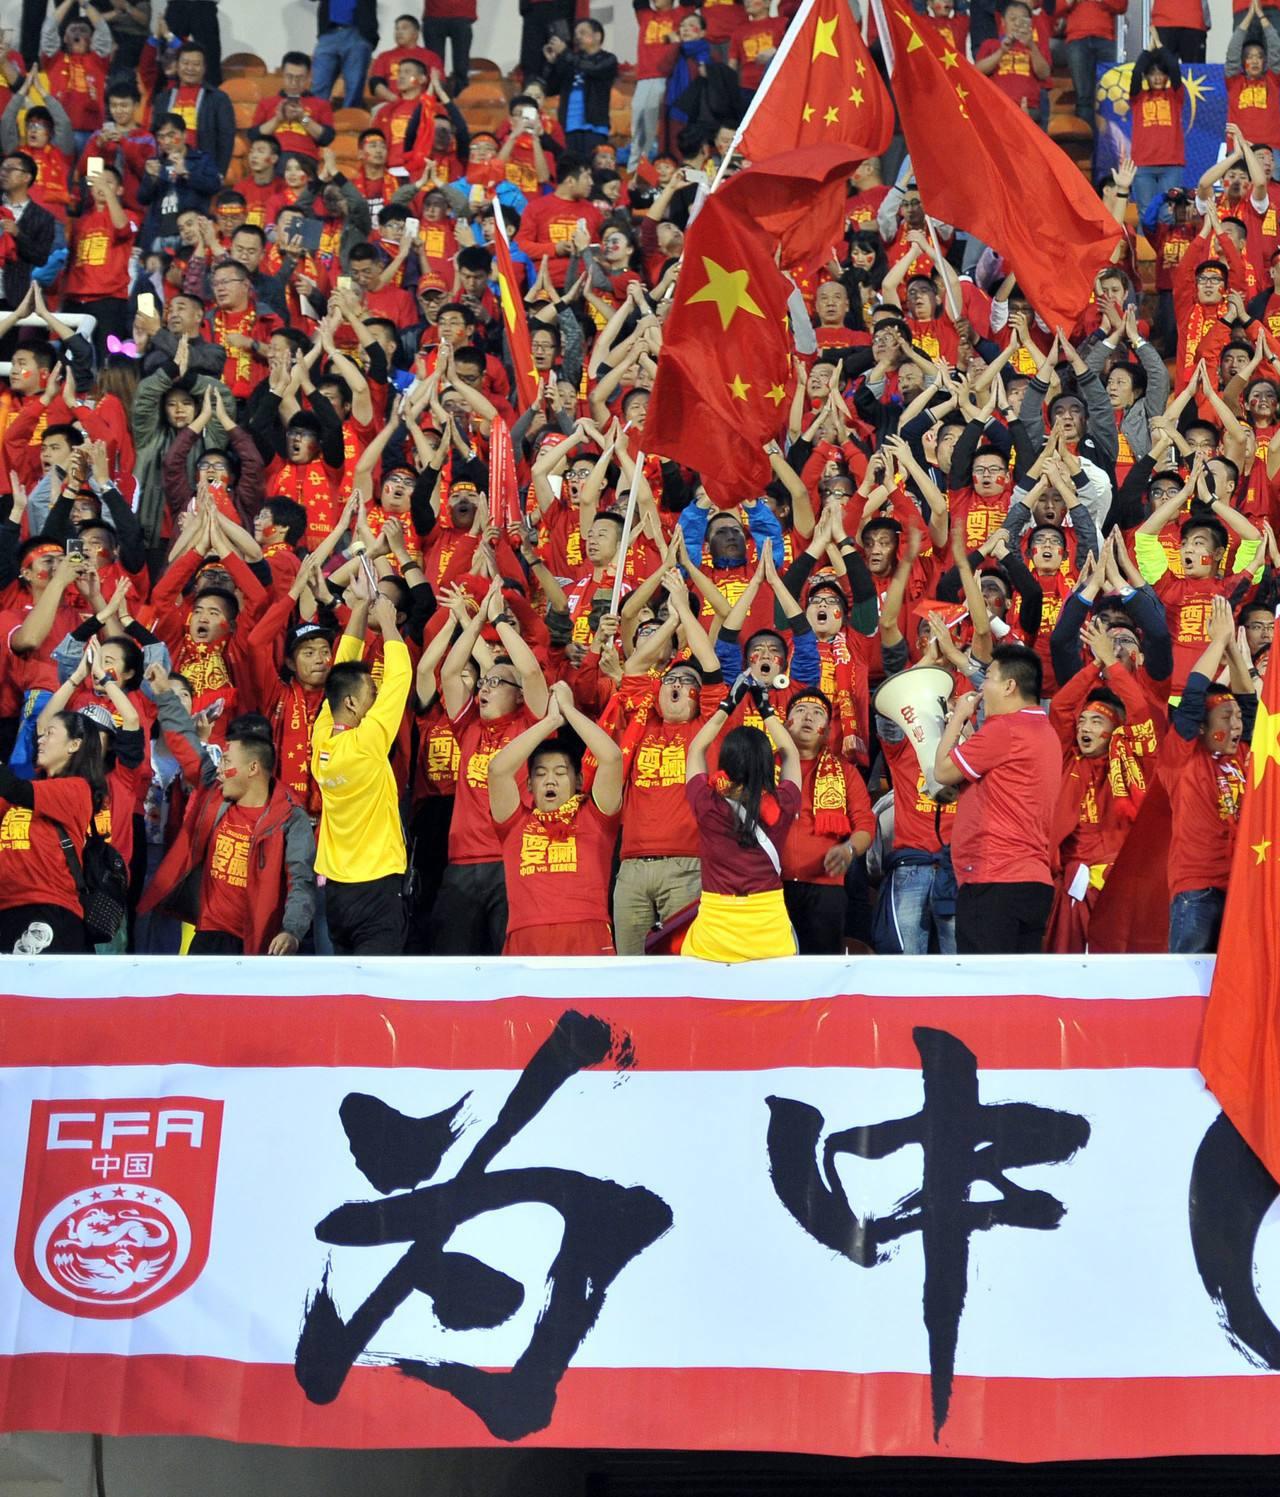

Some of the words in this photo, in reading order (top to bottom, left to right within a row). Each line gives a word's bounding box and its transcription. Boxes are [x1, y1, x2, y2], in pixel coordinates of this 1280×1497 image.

[637, 744, 685, 778] 要赢
[520, 834, 577, 866] 要赢
[46, 1109, 205, 1150] CFA
[91, 1152, 154, 1180] 中国
